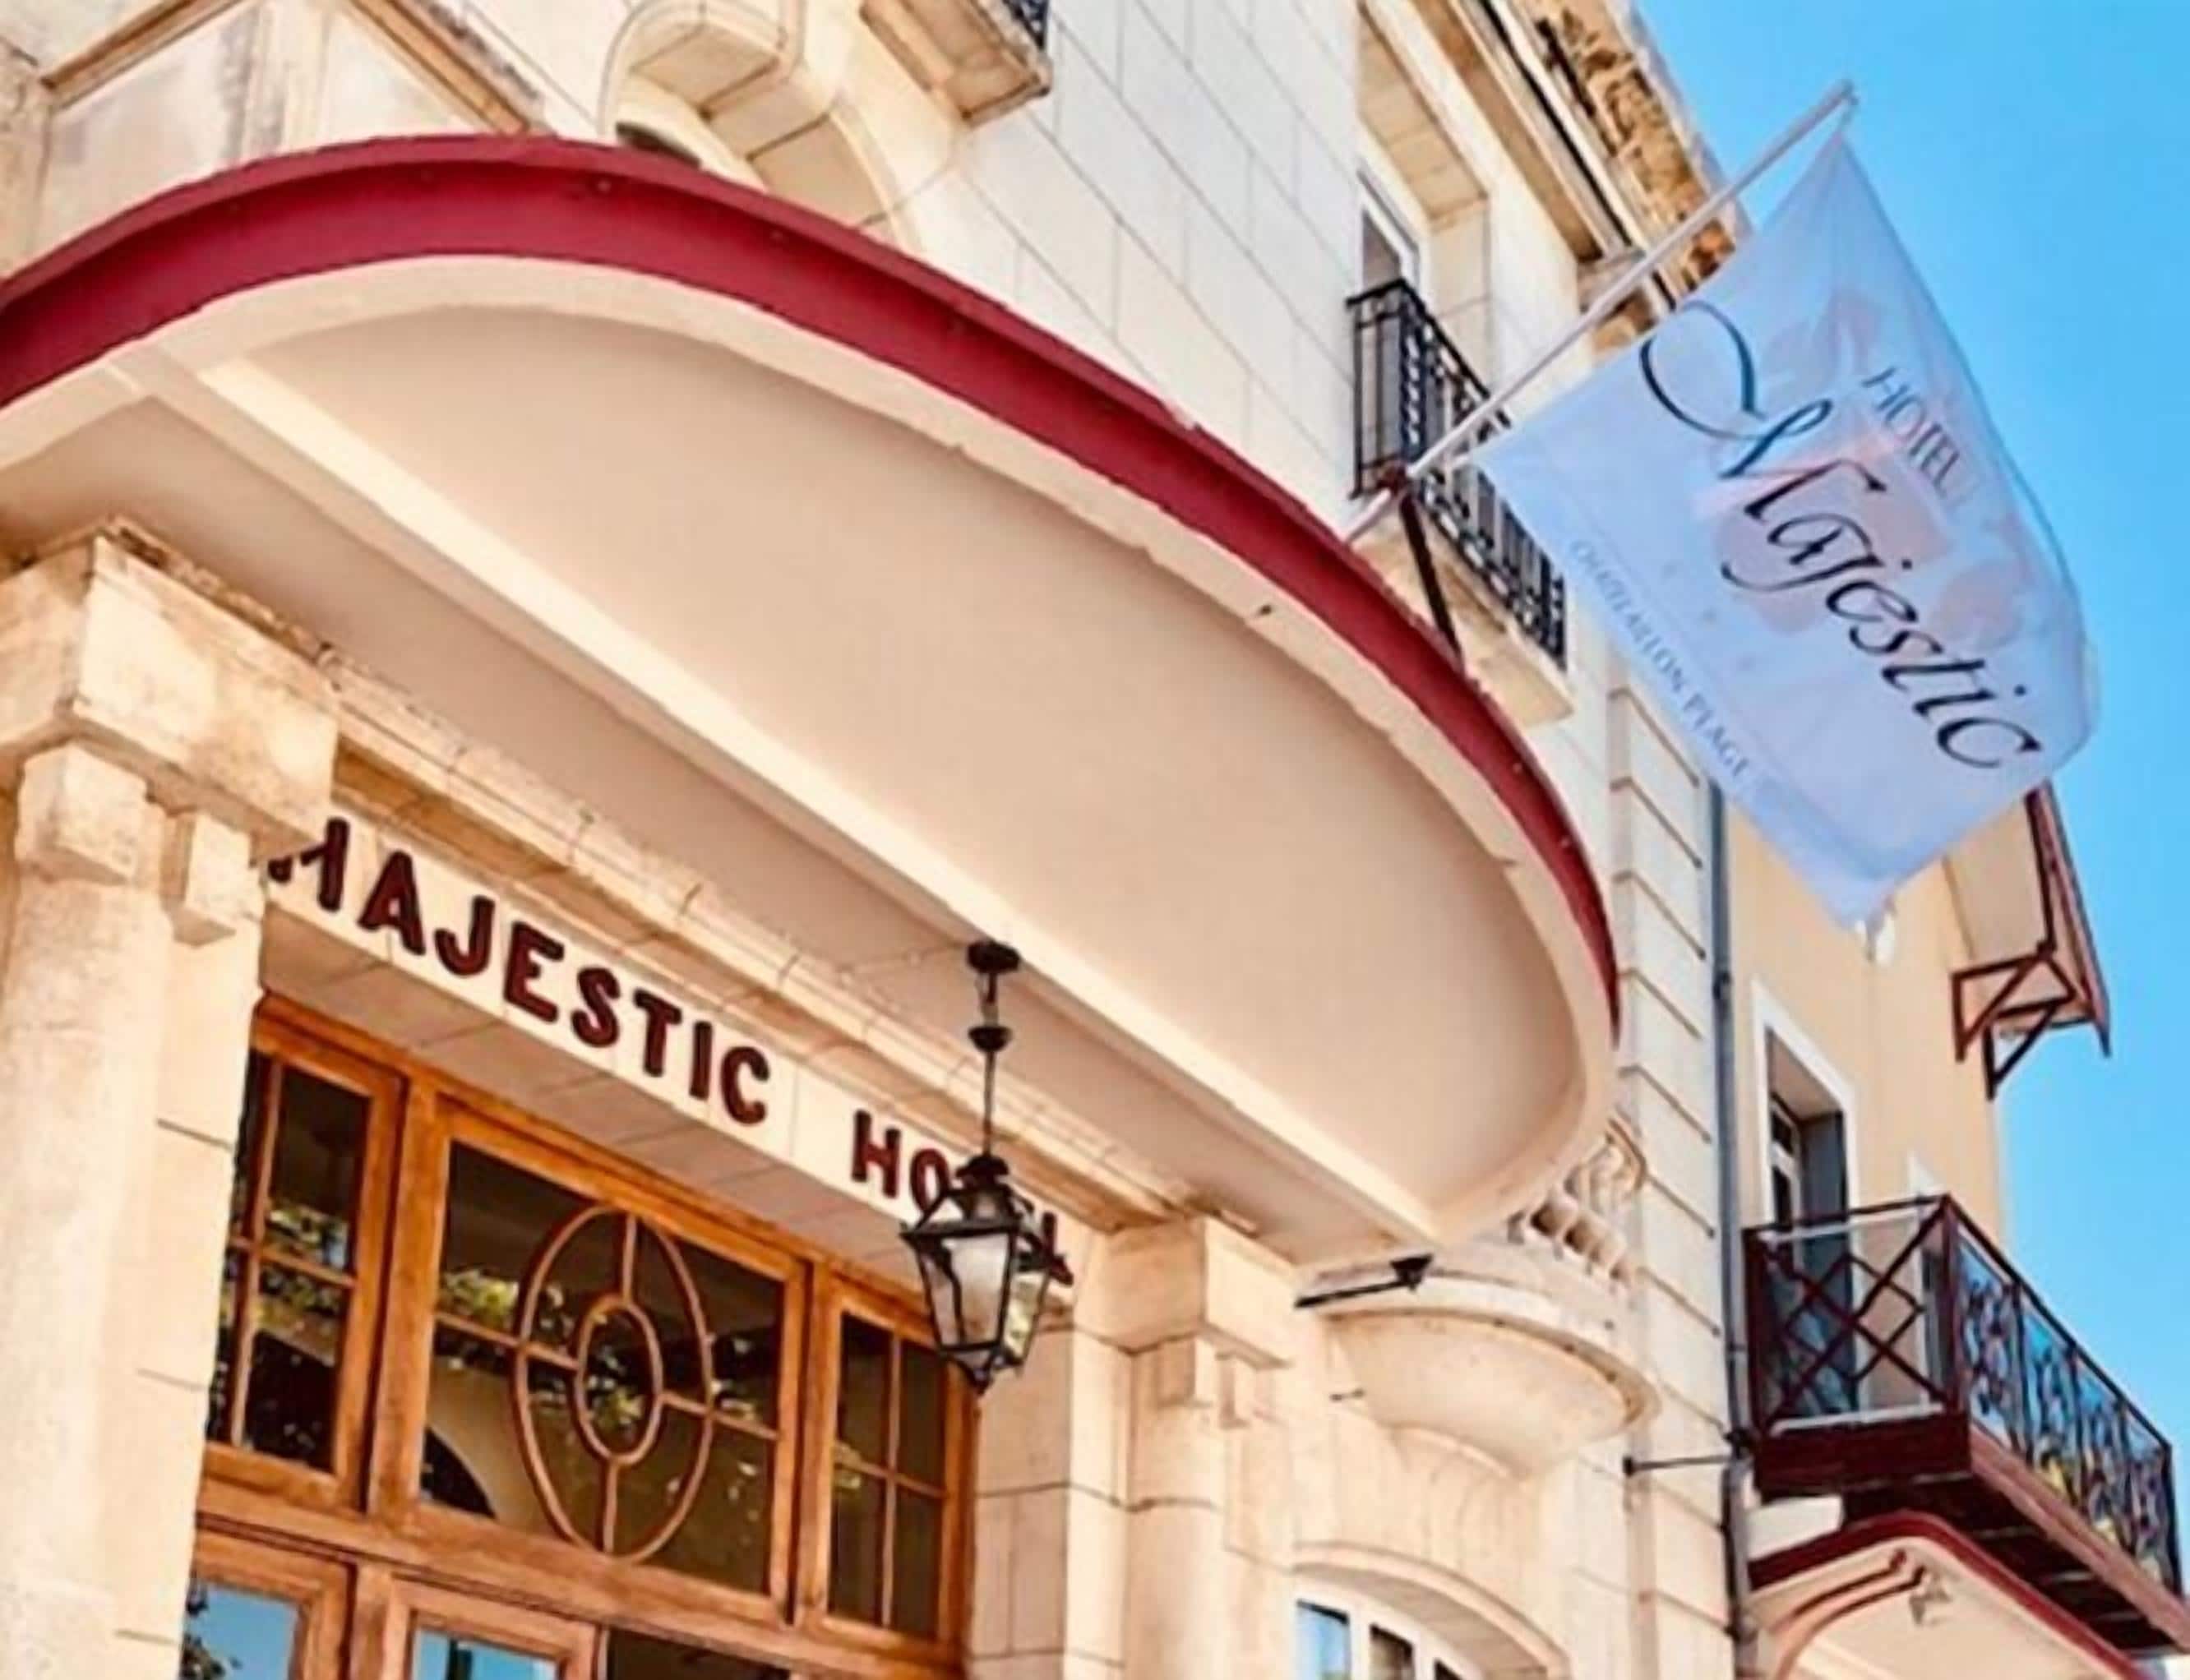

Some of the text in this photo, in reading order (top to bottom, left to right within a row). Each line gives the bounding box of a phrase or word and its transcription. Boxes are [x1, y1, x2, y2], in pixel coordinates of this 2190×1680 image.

[1860, 365, 1961, 497] HOTEL
[1641, 300, 2043, 769] Majestic
[852, 1110, 1074, 1285] HOL
